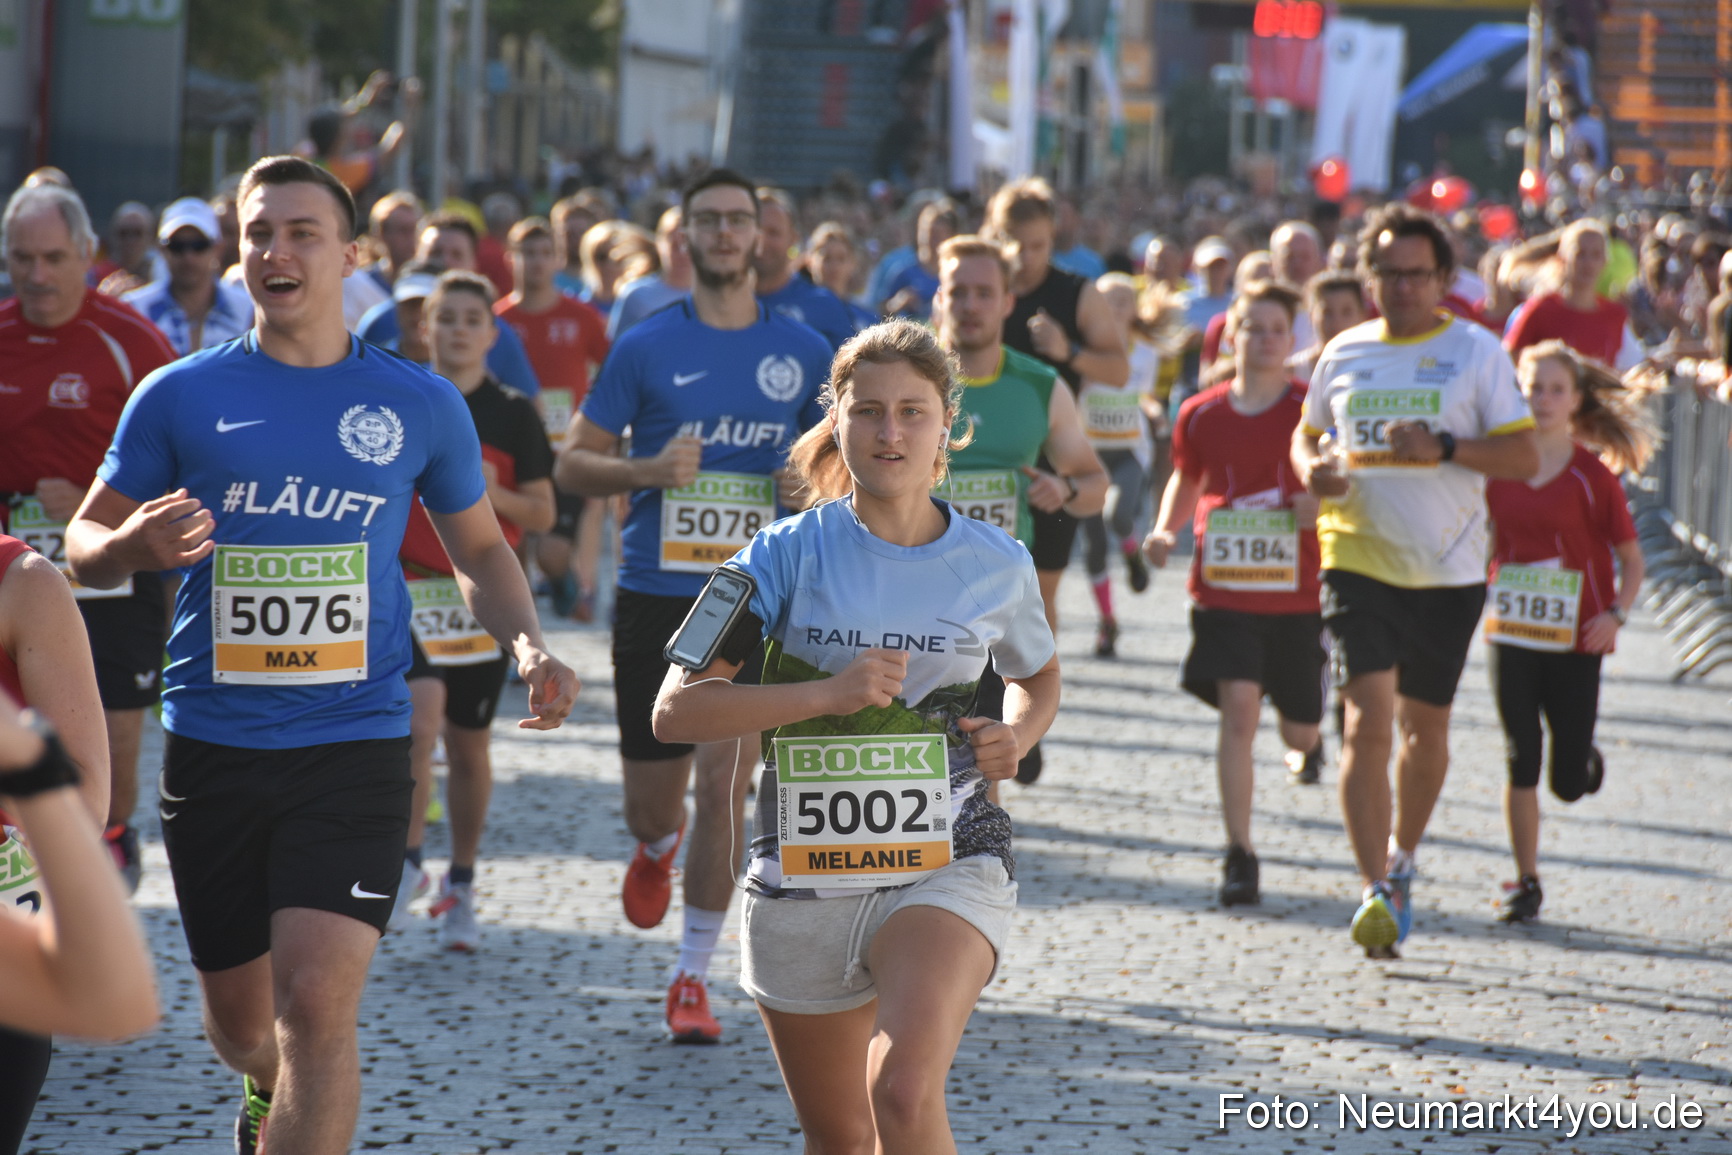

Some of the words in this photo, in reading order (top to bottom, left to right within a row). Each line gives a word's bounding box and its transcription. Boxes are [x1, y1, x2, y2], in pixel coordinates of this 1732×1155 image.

[222, 475, 388, 527] #LÄUFT
[936, 474, 1006, 498] OCK
[676, 506, 762, 540] 5078
[692, 547, 733, 560] KEV
[1213, 537, 1285, 562] 5184
[224, 550, 357, 583] BOCK
[231, 594, 352, 636] 5076
[1496, 591, 1565, 623] 5183
[806, 628, 946, 653] RAIL.ONE
[265, 651, 318, 668] MAX
[788, 742, 934, 777] BOCK
[798, 789, 930, 836] 5002
[935, 791, 943, 801] S
[808, 849, 923, 870] MELANIE
